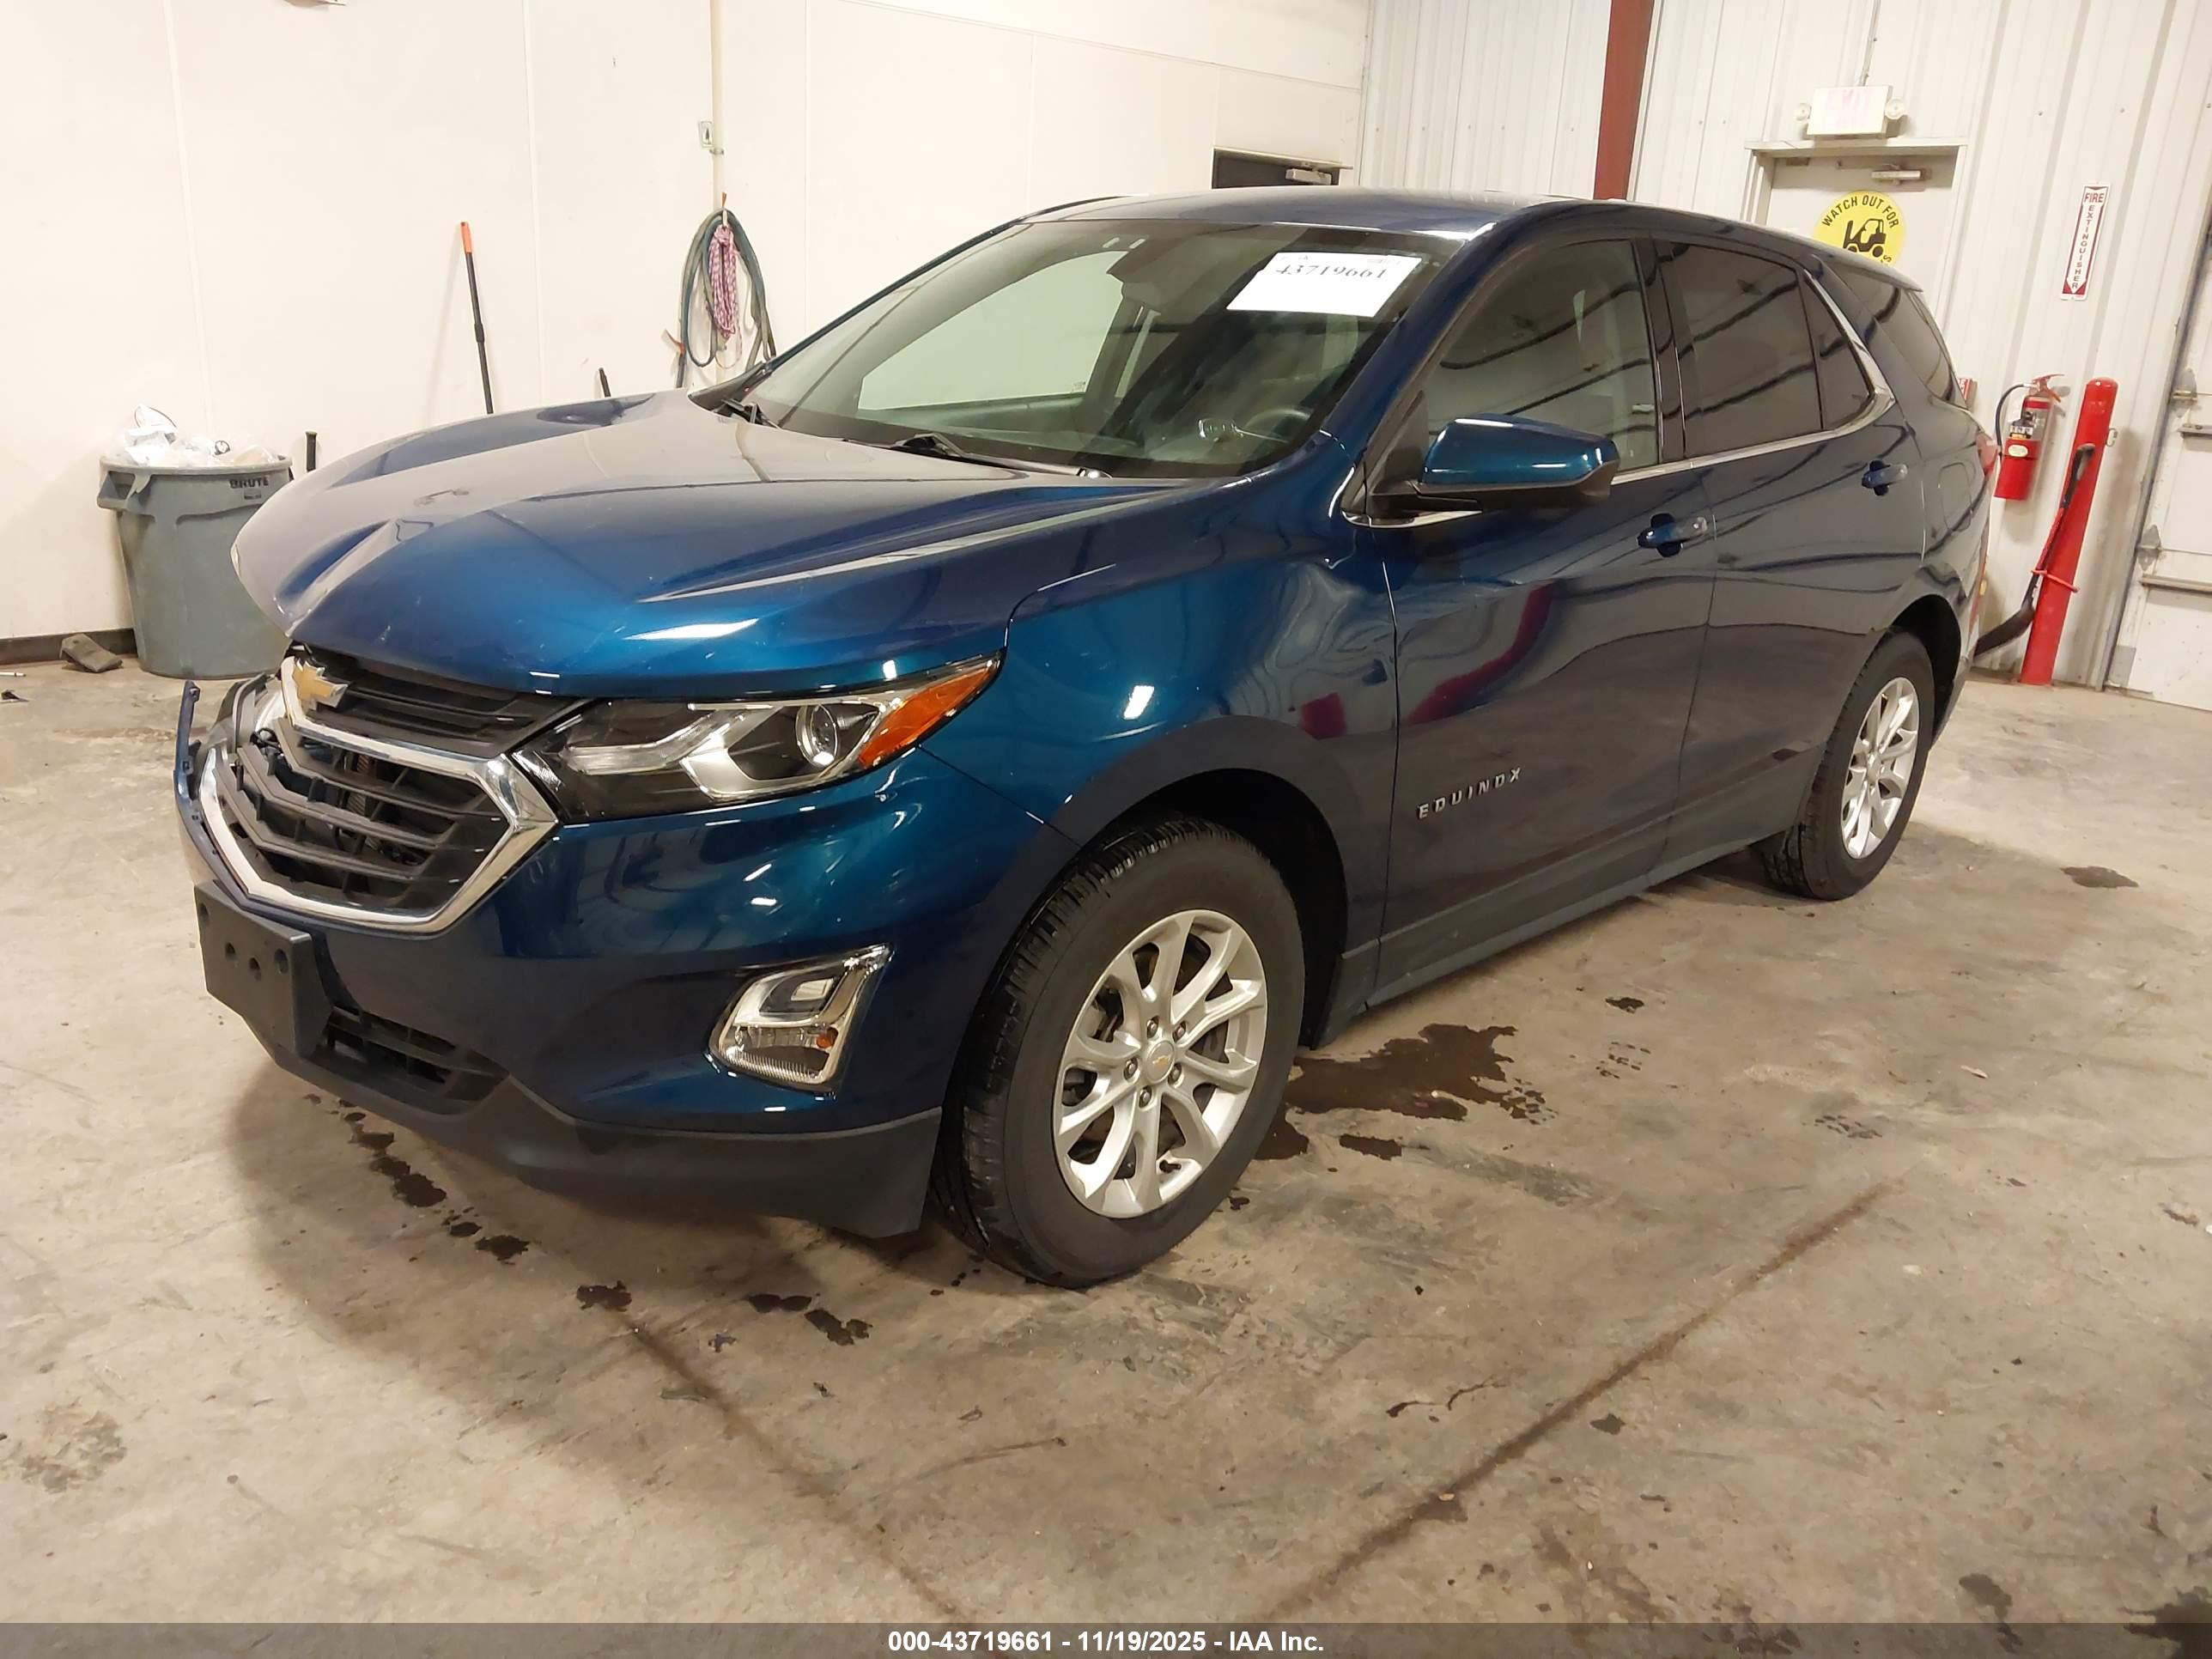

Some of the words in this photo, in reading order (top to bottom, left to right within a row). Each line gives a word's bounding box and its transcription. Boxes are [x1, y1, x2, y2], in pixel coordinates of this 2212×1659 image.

[1821, 196, 1858, 227] WATCH
[1862, 194, 1885, 210] OUT
[1881, 204, 1899, 228] FOR
[2083, 192, 2105, 204] FIRE
[2071, 204, 2095, 289] EXTINGUISHER
[1275, 264, 1388, 279] 43719661
[1418, 767, 1522, 819] EQUINOX
